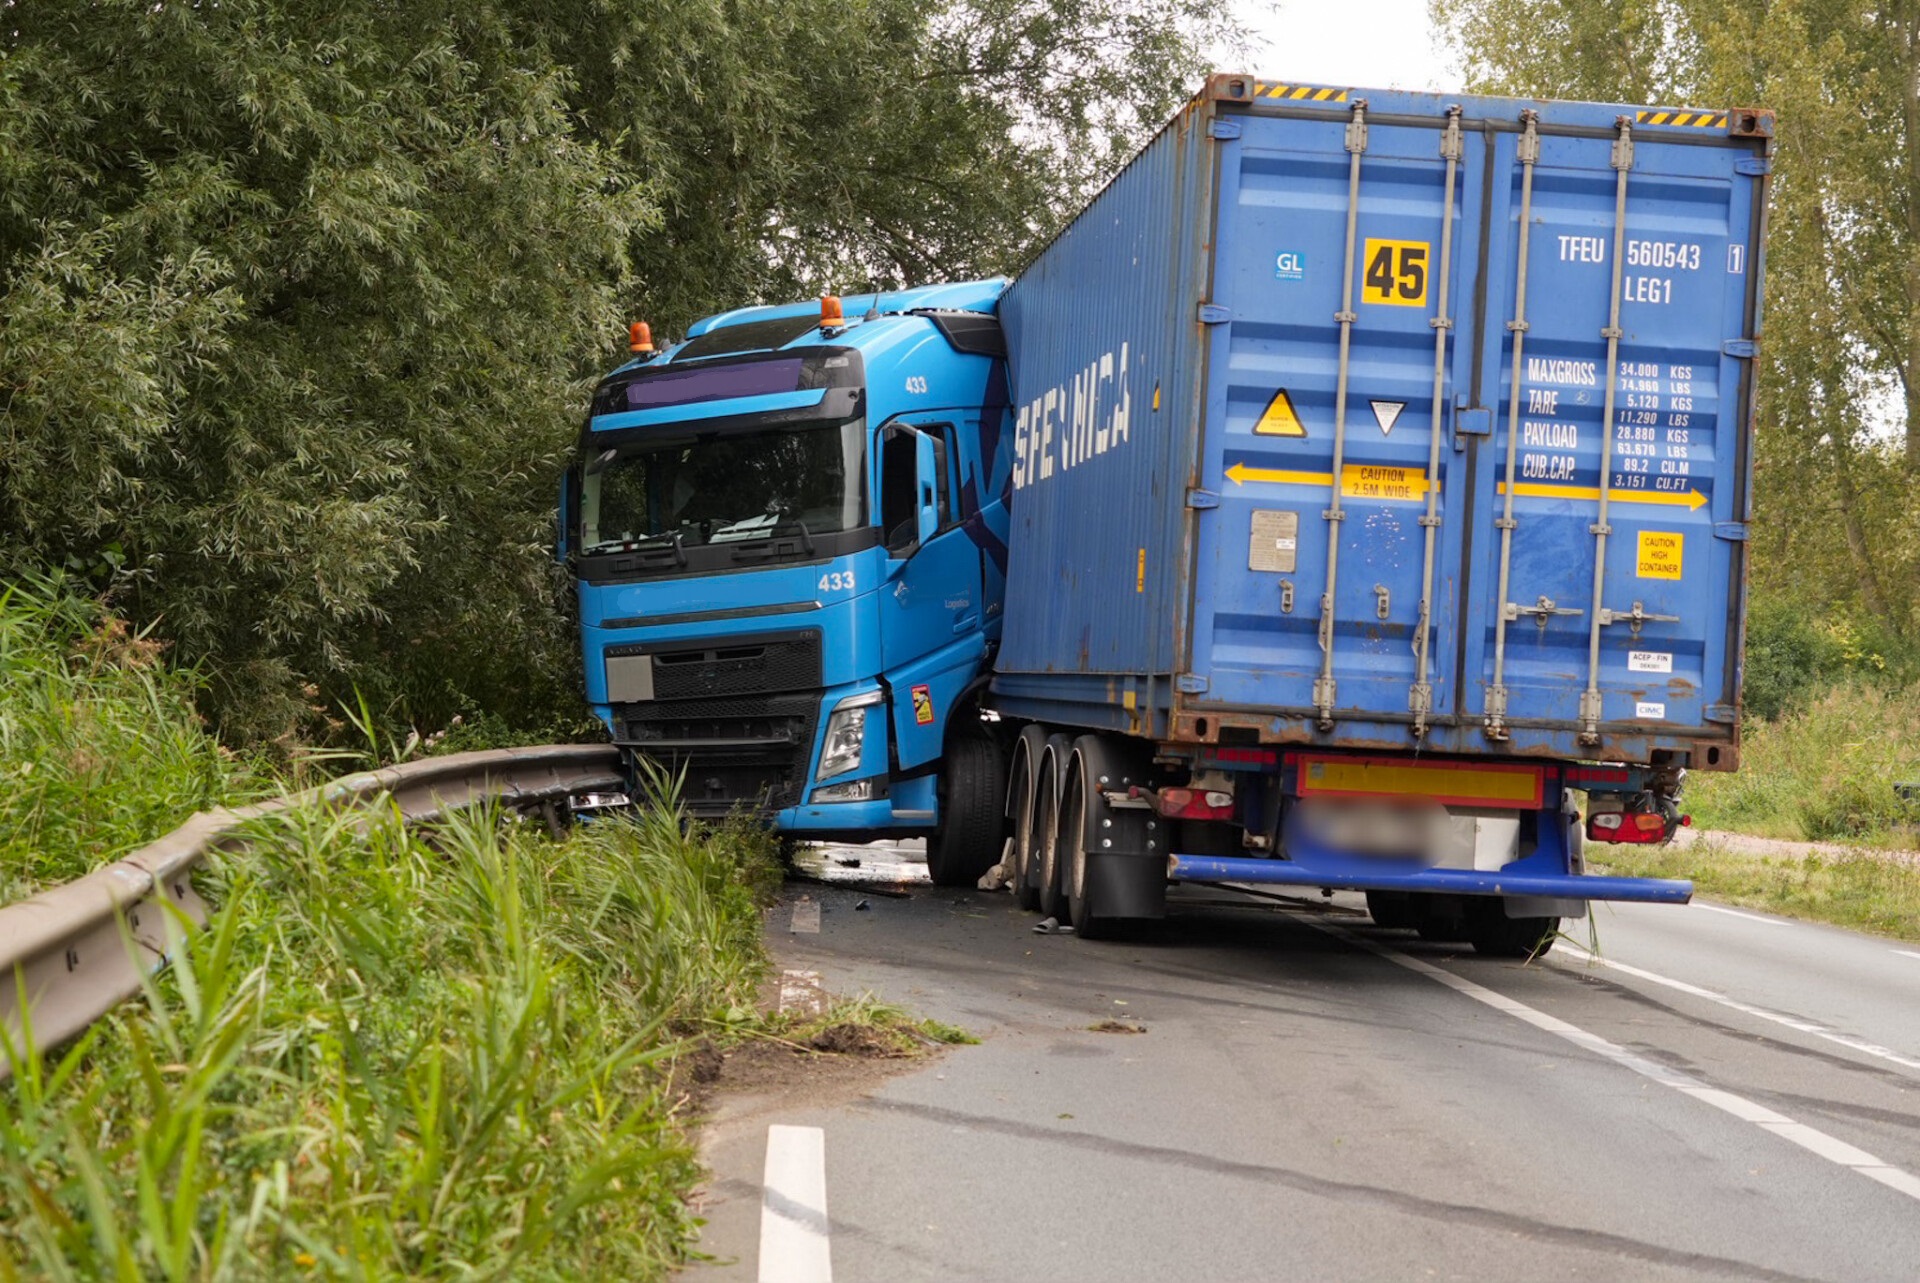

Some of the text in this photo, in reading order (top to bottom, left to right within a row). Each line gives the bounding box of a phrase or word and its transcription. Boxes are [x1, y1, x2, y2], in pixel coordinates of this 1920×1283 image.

[1558, 235, 1741, 272] TFEU 560543 1
[1277, 253, 1302, 271] GL
[1366, 246, 1425, 299] 45
[1624, 276, 1671, 304] LEG1
[1528, 358, 1692, 386] MAXGROSS 34.000 KGS
[905, 376, 927, 394] 433
[1621, 379, 1691, 395] 74.960 LBS
[1528, 389, 1693, 415] TARE 5.120 KGS
[1620, 411, 1689, 427] 11.290 LBS
[1524, 422, 1689, 448] PAYLOAD 28.880 KGS
[1617, 443, 1687, 459] 63.670 LBS
[1361, 467, 1405, 482] CAUTION
[1522, 453, 1689, 480] CUB.CAP. 89.2 CU.M
[1353, 482, 1411, 498] 2.5M WIDE
[1615, 475, 1687, 491] 3.151 CU.FT
[1645, 537, 1676, 548] CAUTION
[1651, 550, 1668, 560] HIGH
[1639, 562, 1678, 573] CONTAINER
[818, 571, 855, 592] 433
[1633, 653, 1651, 661] ACEP
[1639, 706, 1662, 715] CIMC
